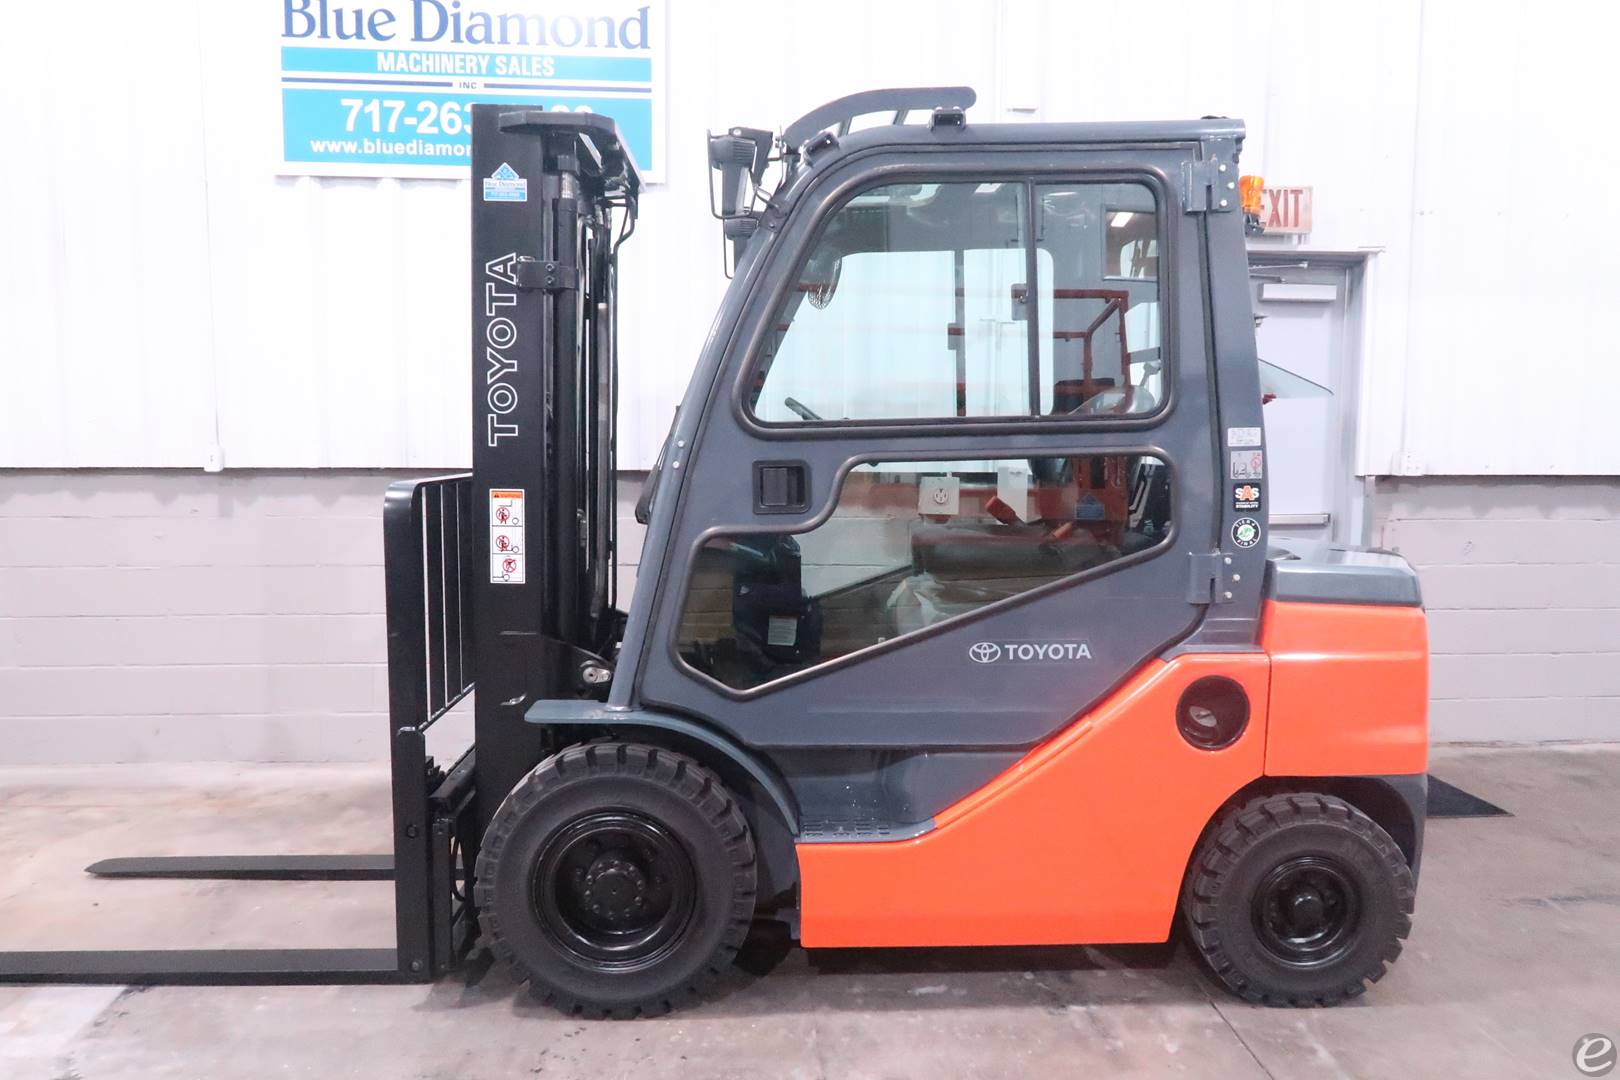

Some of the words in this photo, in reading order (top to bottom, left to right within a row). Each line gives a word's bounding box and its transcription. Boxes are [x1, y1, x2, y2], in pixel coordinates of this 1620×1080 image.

[281, 0, 396, 41] Blue
[410, 0, 652, 50] Diamond
[376, 51, 489, 75] MACHINERY
[495, 58, 555, 77] SALES
[459, 81, 477, 90] INC
[486, 252, 518, 447] TOYOTA
[1235, 485, 1260, 501] SAS
[1004, 643, 1092, 660] TOYOTA
